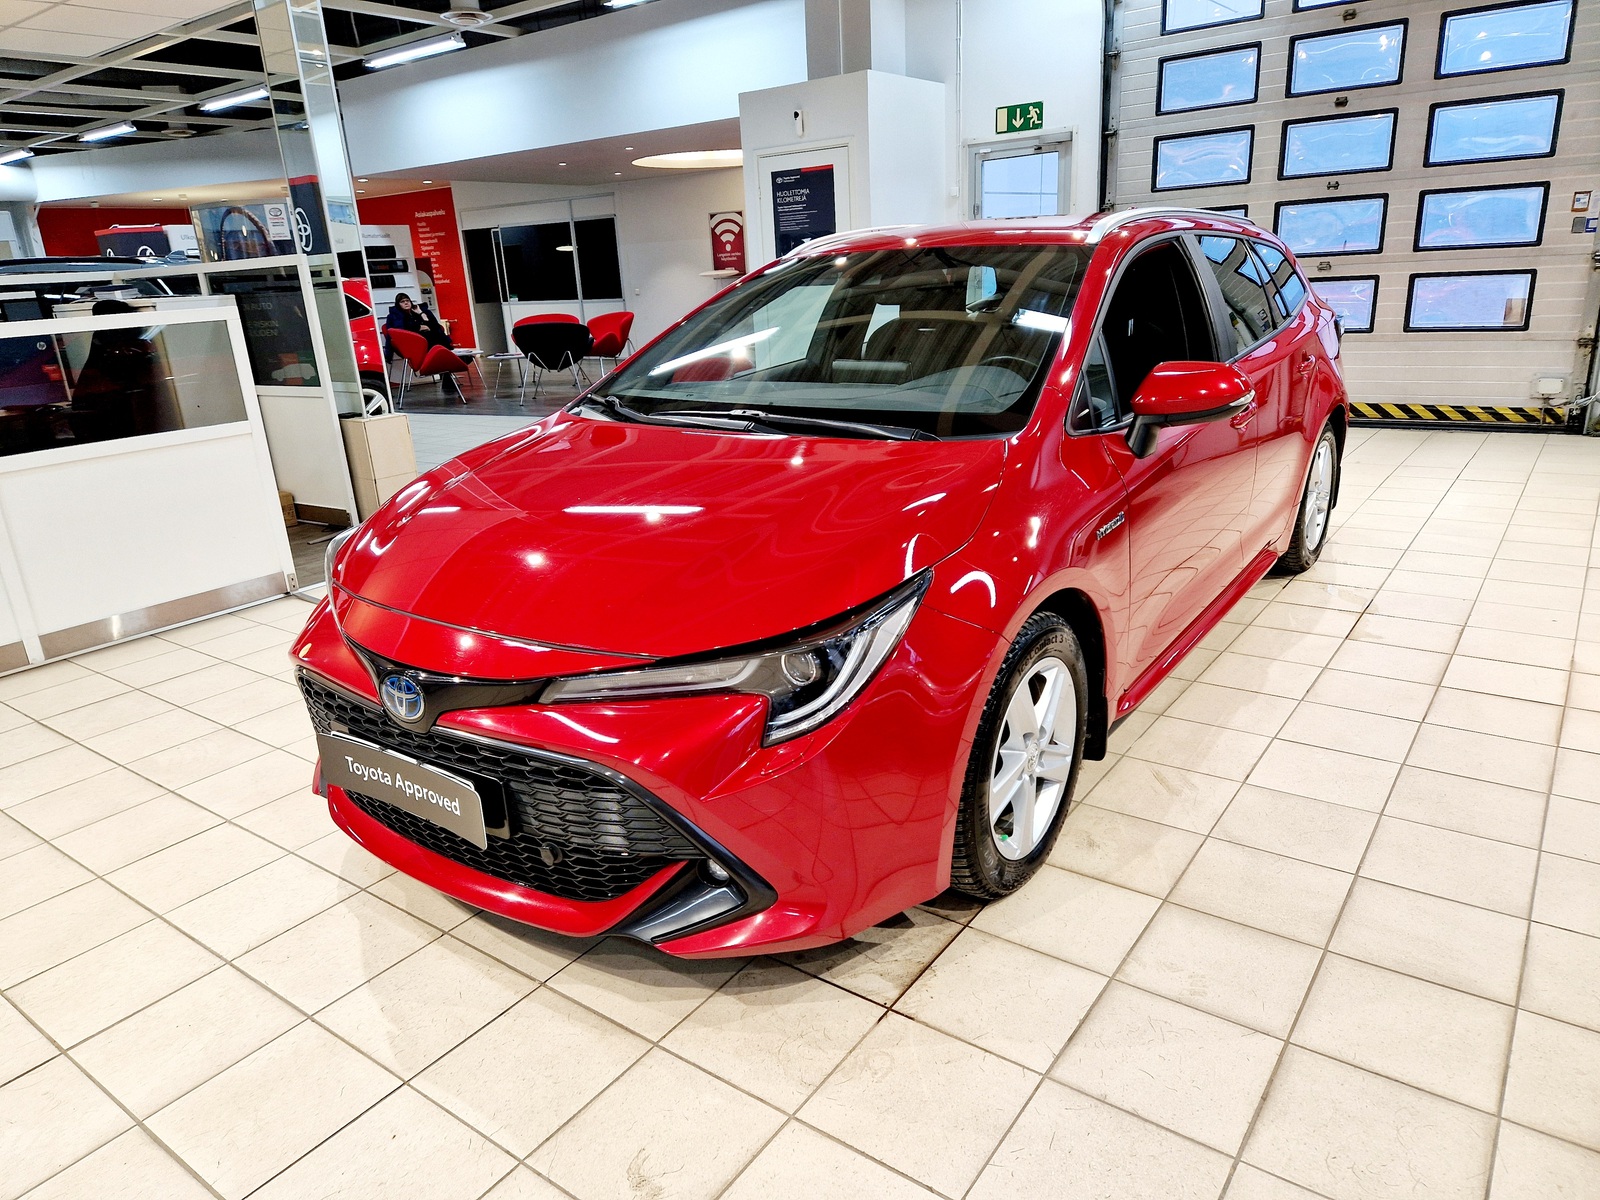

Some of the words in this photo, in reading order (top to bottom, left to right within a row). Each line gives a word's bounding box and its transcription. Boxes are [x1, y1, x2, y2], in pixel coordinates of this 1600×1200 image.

[776, 188, 810, 197] HUOLETTOMIA
[777, 195, 807, 204] KILOMETREJÄ
[1017, 634, 1058, 676] IceContact
[345, 755, 392, 786] Toyota
[395, 771, 461, 817] Approved
